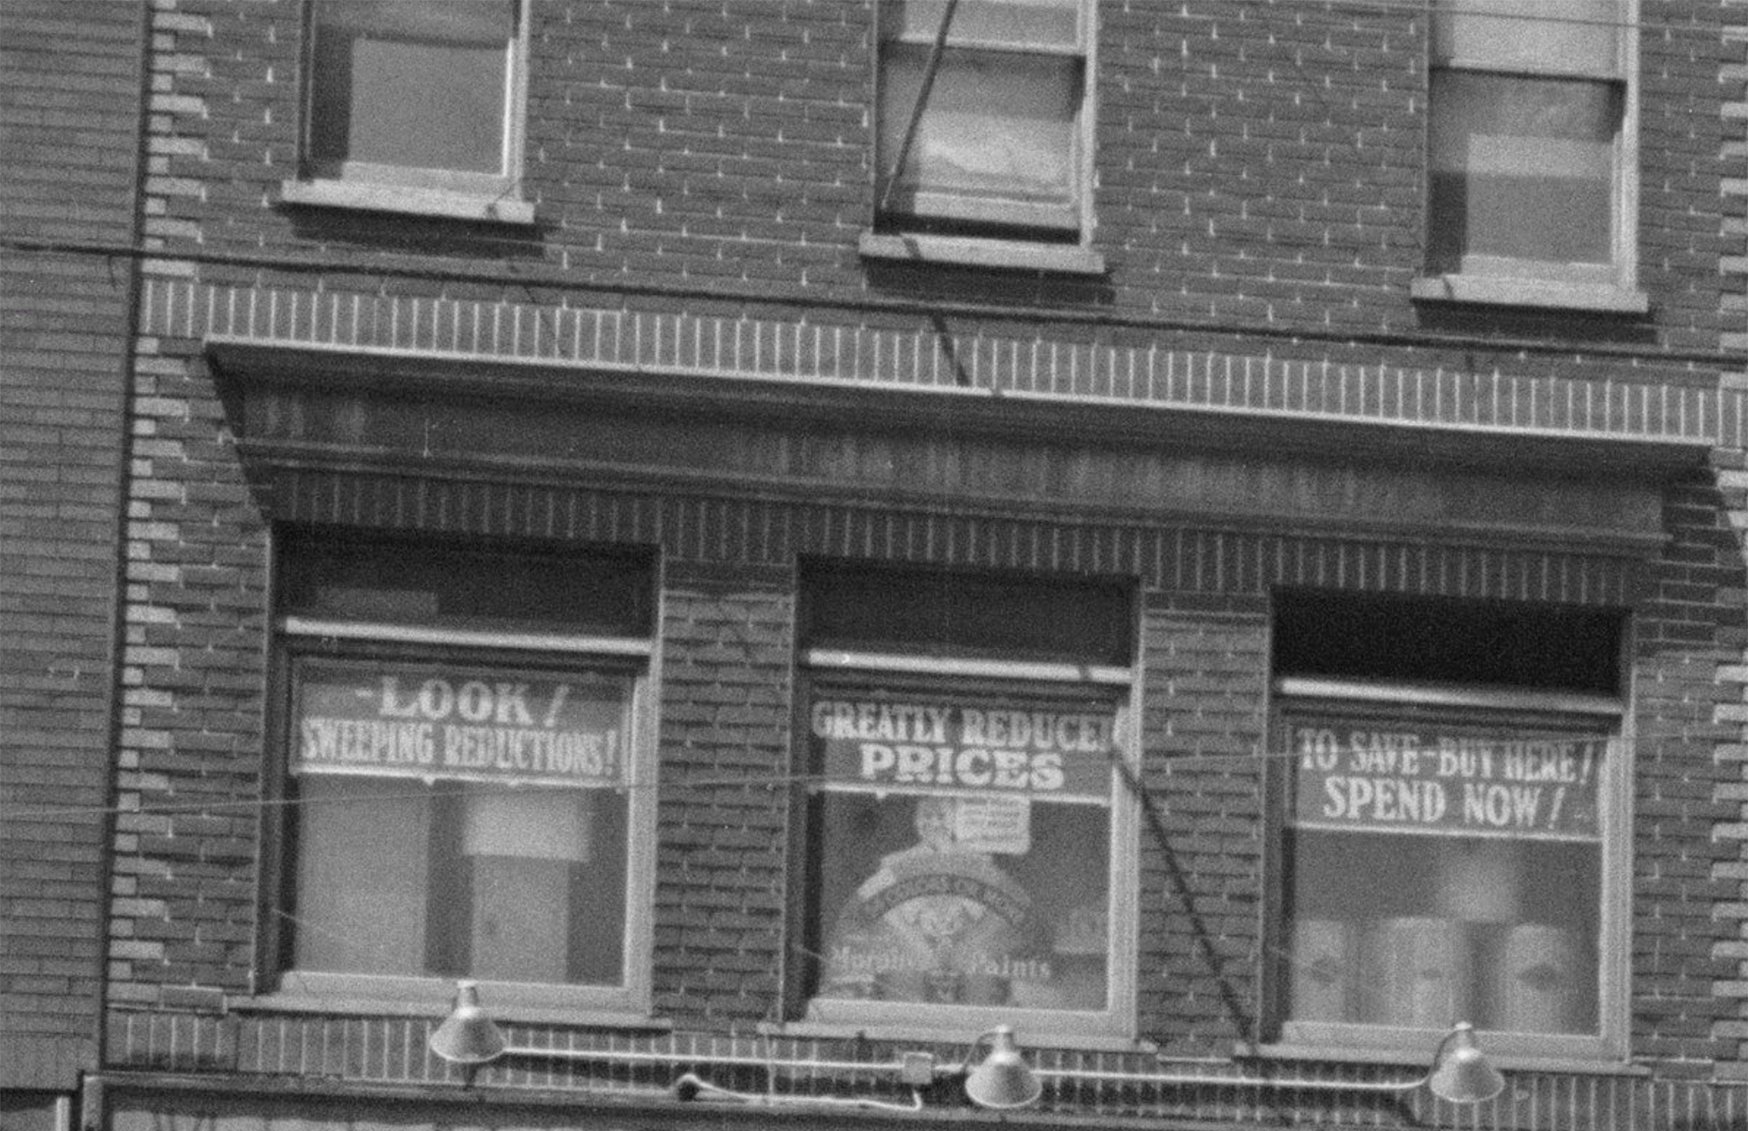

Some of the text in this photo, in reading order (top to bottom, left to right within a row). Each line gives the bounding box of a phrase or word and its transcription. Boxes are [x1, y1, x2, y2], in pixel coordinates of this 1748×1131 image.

[301, 716, 618, 776] SWEEPING REDUCTIONS!
[812, 700, 951, 745] GREATLY
[860, 743, 1064, 790] PRICES
[1298, 726, 1339, 772] TO
[1503, 740, 1593, 786] HERE!
[1322, 775, 1566, 830] SPEND NOW!
